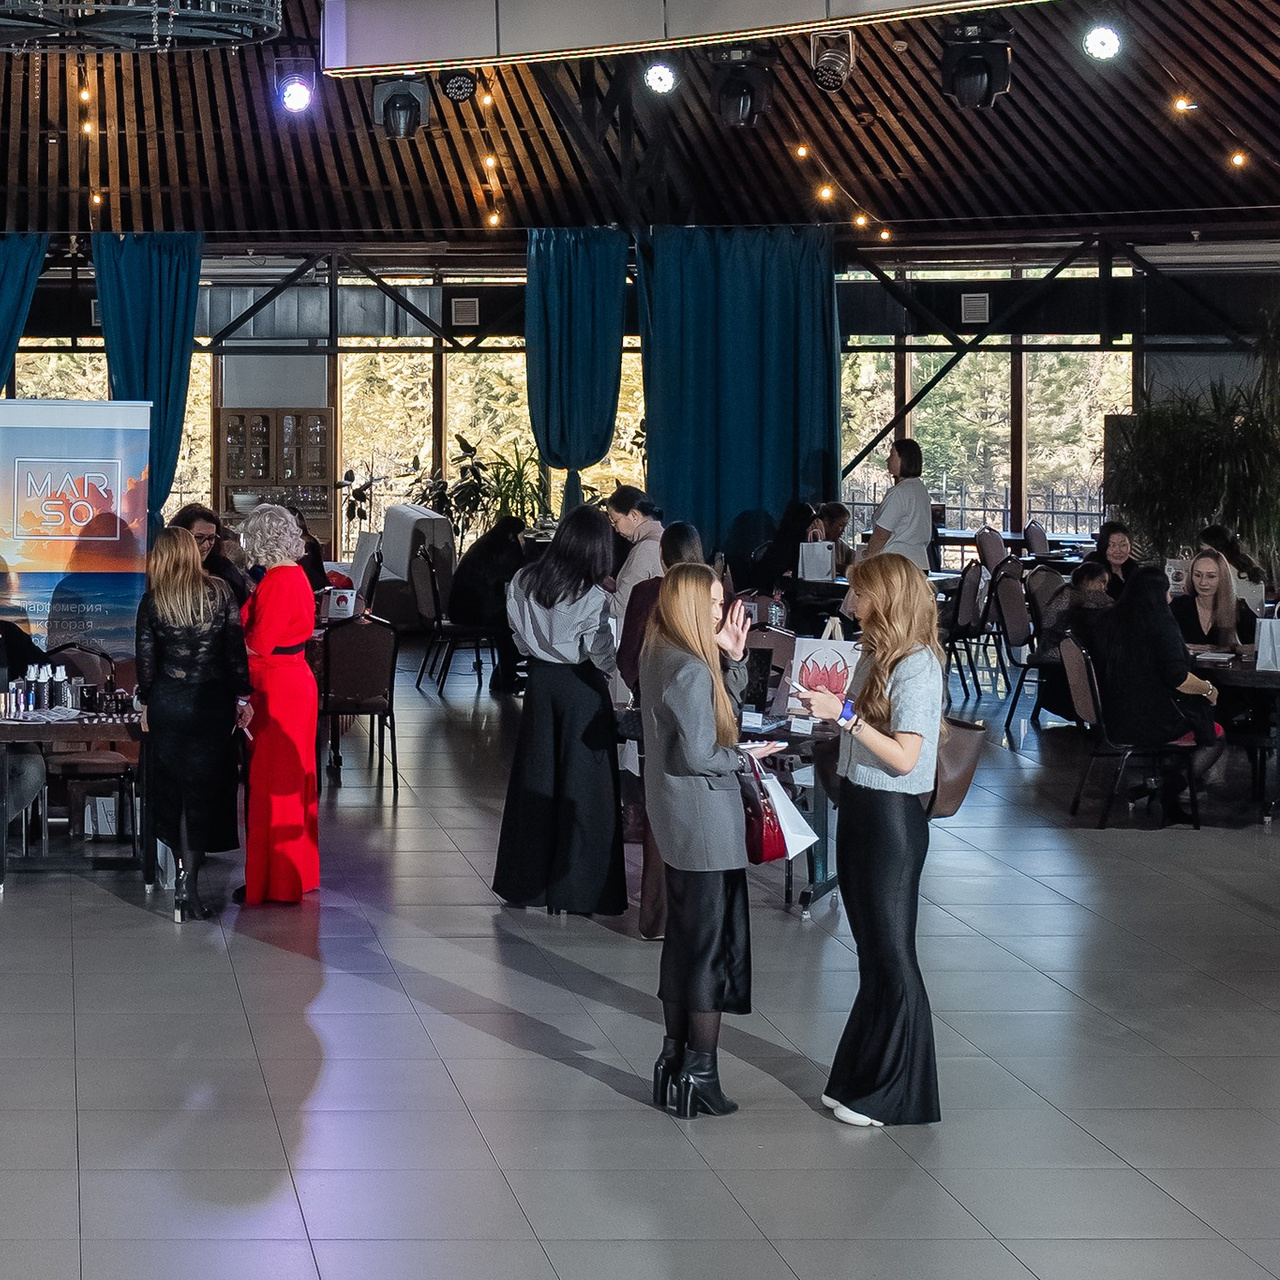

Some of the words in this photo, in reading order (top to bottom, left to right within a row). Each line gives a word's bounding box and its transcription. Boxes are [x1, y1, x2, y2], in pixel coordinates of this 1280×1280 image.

[27, 471, 108, 498] MAR
[41, 500, 93, 526] SO
[36, 620, 94, 631] которая
